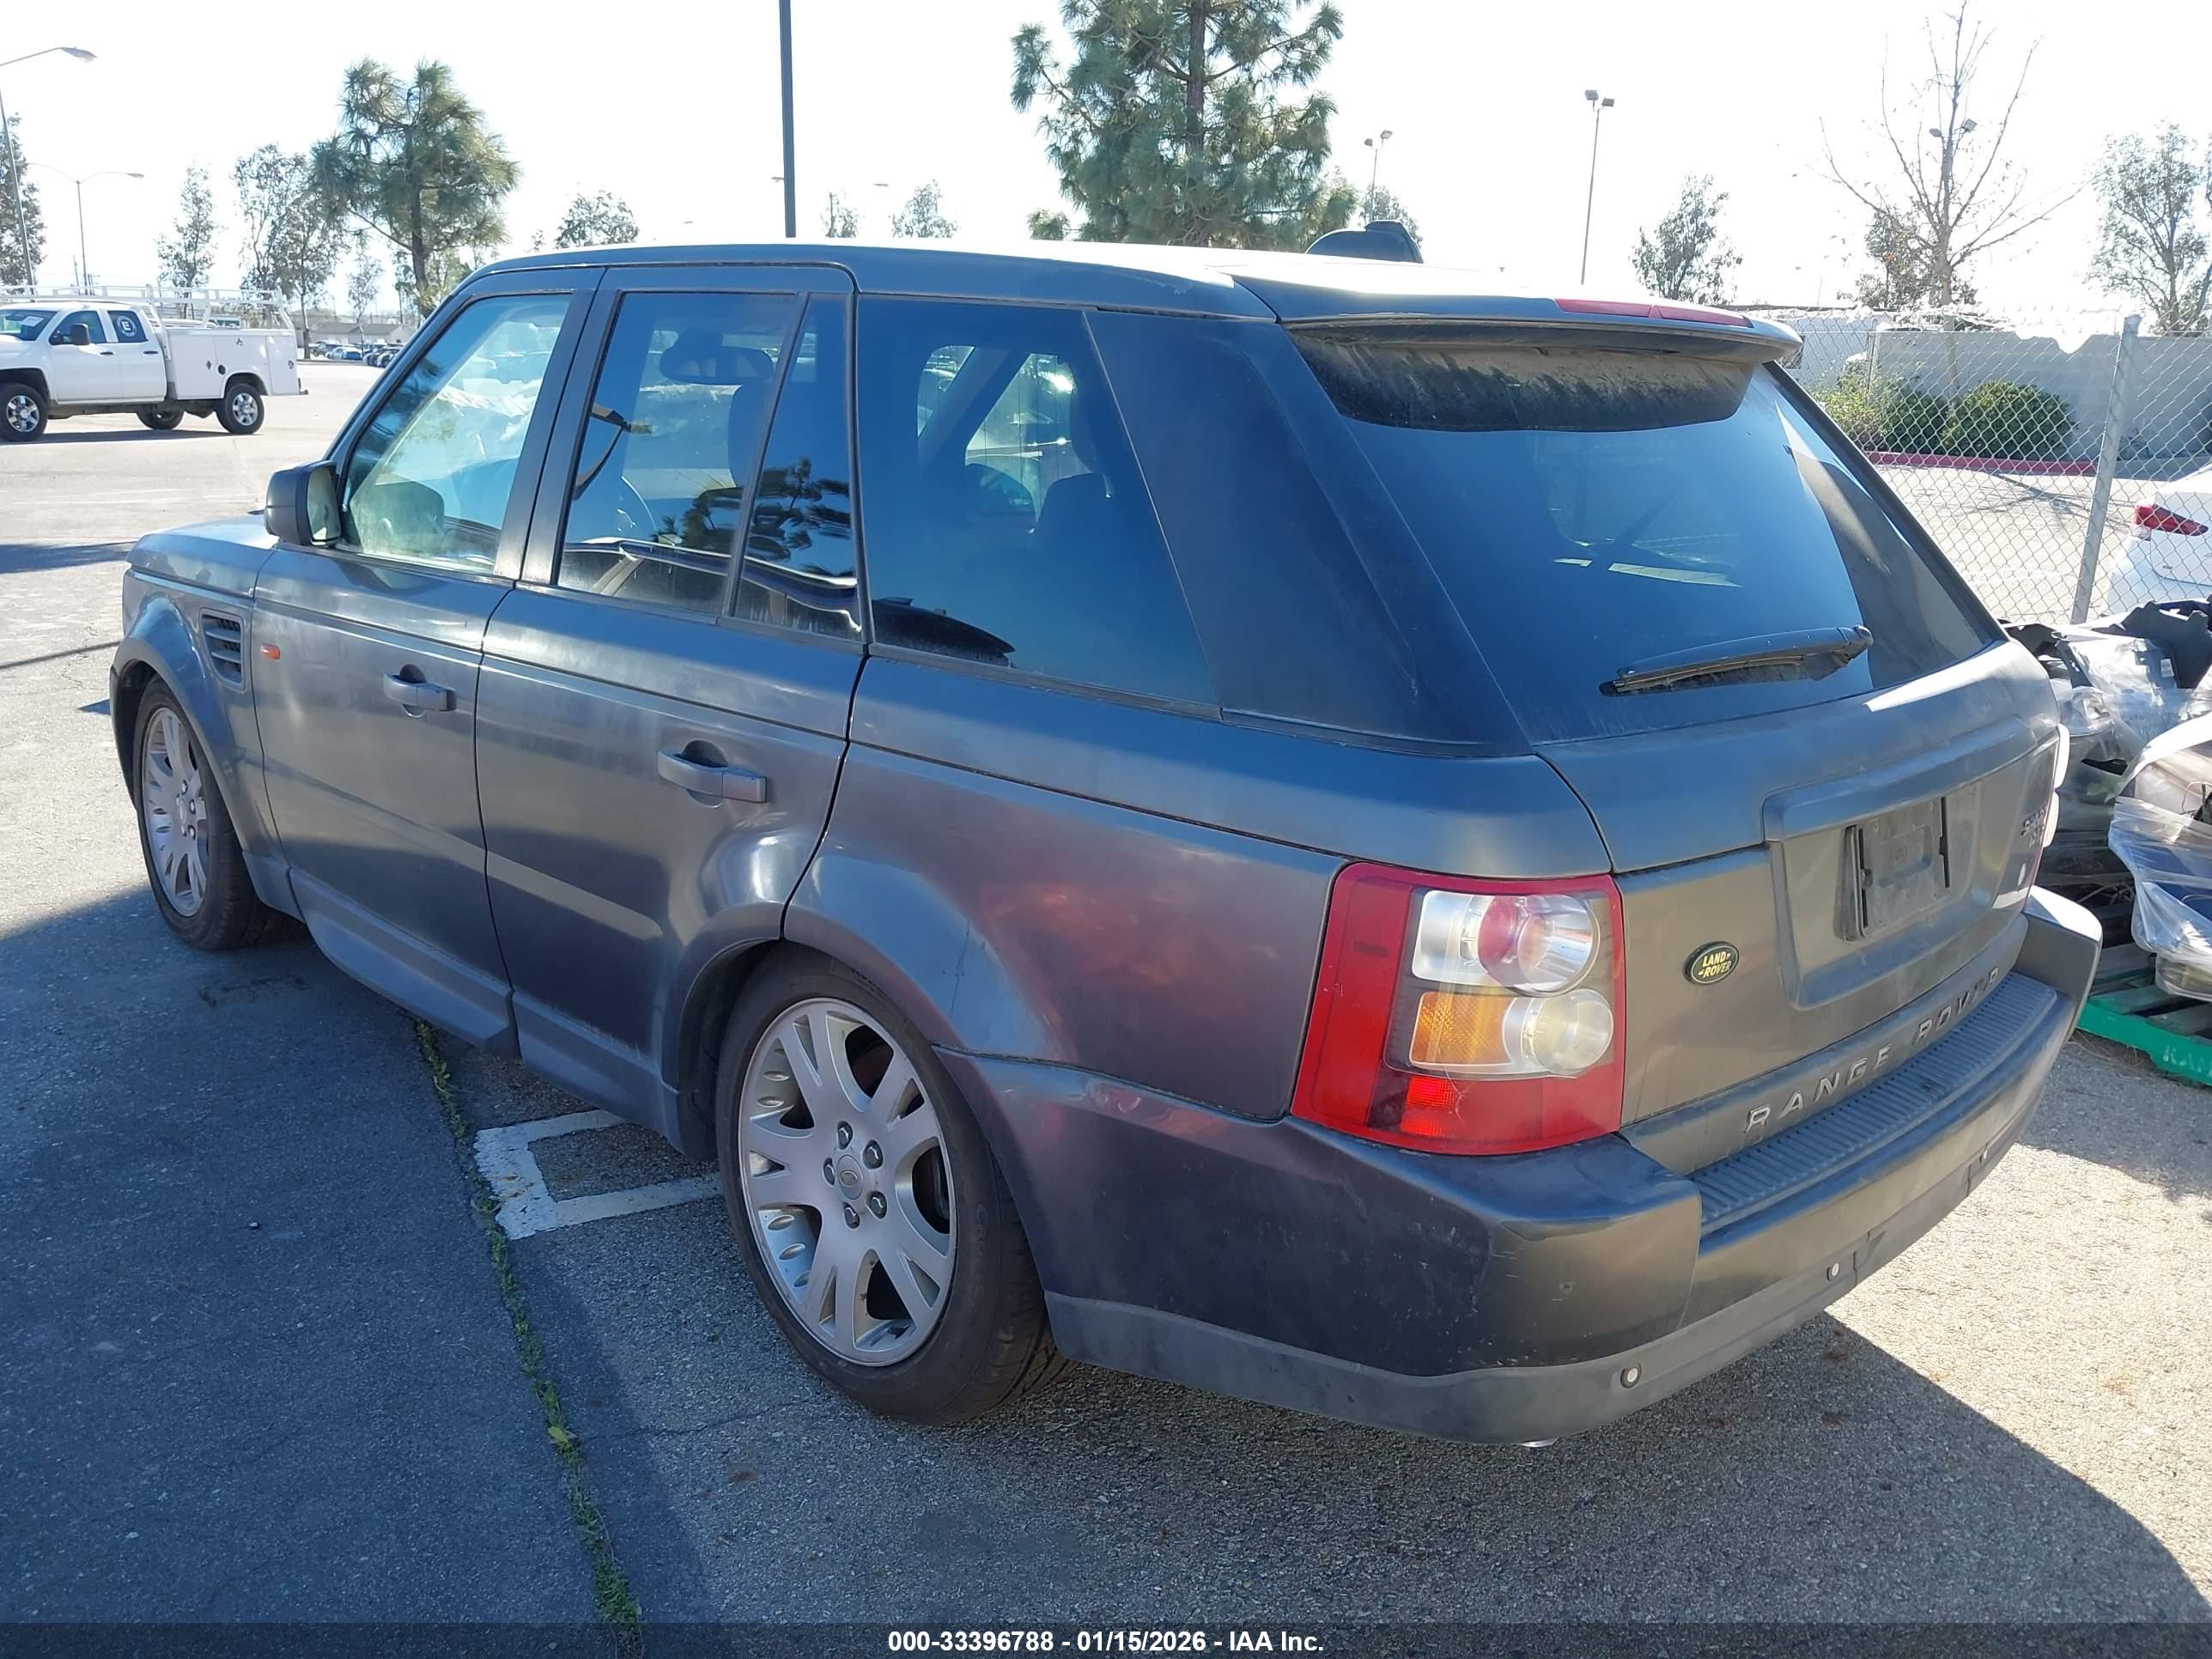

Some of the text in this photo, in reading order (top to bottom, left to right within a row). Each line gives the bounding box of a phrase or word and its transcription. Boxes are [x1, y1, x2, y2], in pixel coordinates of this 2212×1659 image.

[1702, 951, 1727, 968] LAND
[1703, 960, 1732, 978] ROVER
[1743, 1043, 1893, 1134] RANGE
